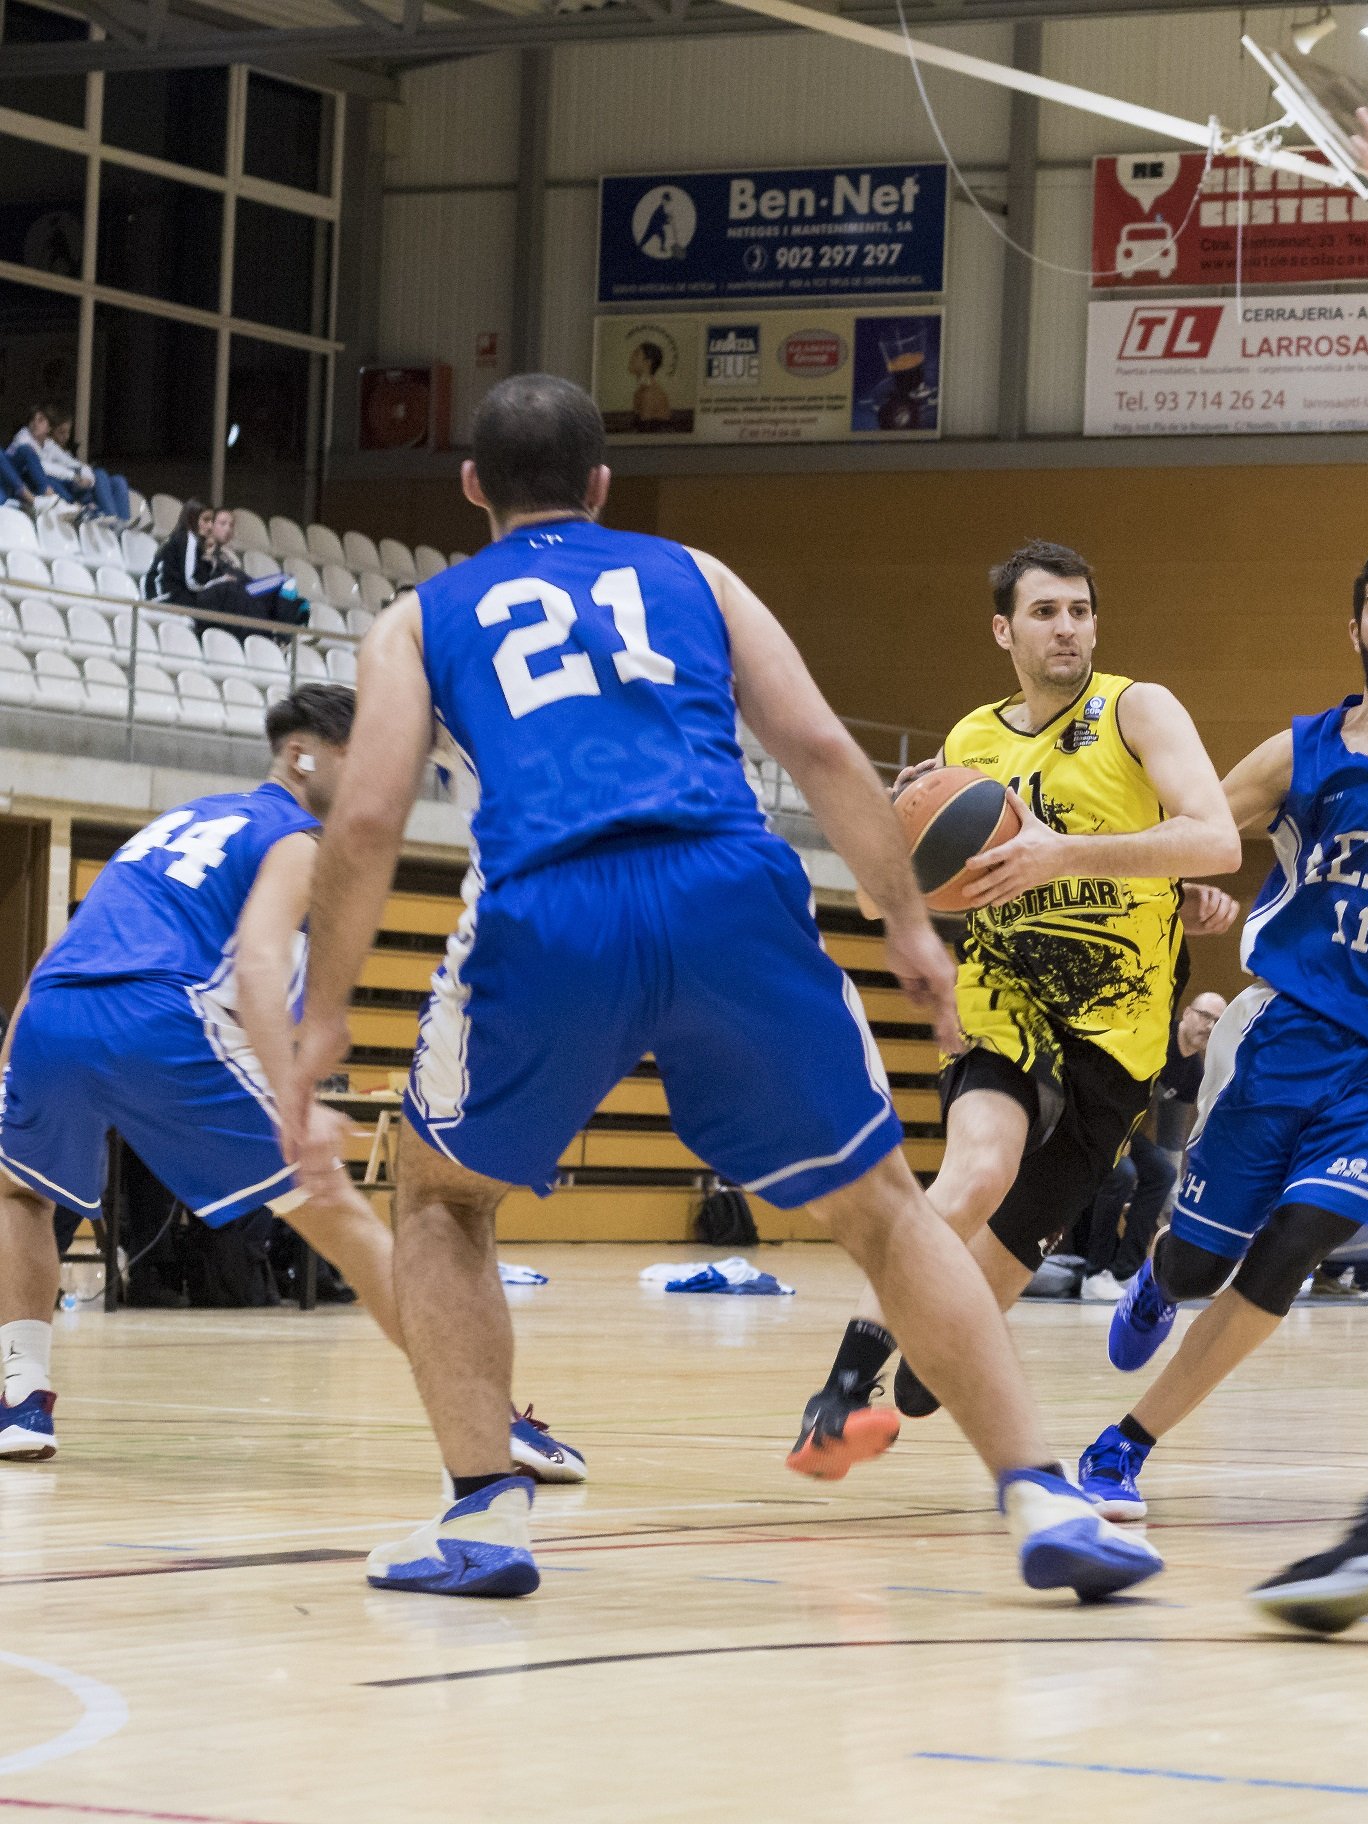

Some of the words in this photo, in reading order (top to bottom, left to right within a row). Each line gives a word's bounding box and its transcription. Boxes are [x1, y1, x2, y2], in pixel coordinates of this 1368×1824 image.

[775, 246, 814, 269] 902
[819, 244, 859, 267] 297
[862, 243, 903, 266] 297
[1132, 309, 1202, 354] TL
[1243, 306, 1343, 323] CERRAJERIA
[1115, 390, 1149, 412] Tel.
[1154, 390, 1179, 411] 93
[1186, 390, 1223, 411] 714
[1230, 389, 1254, 410] 26
[1261, 388, 1285, 409] 24
[474, 566, 676, 720] 21
[114, 810, 251, 890] 44
